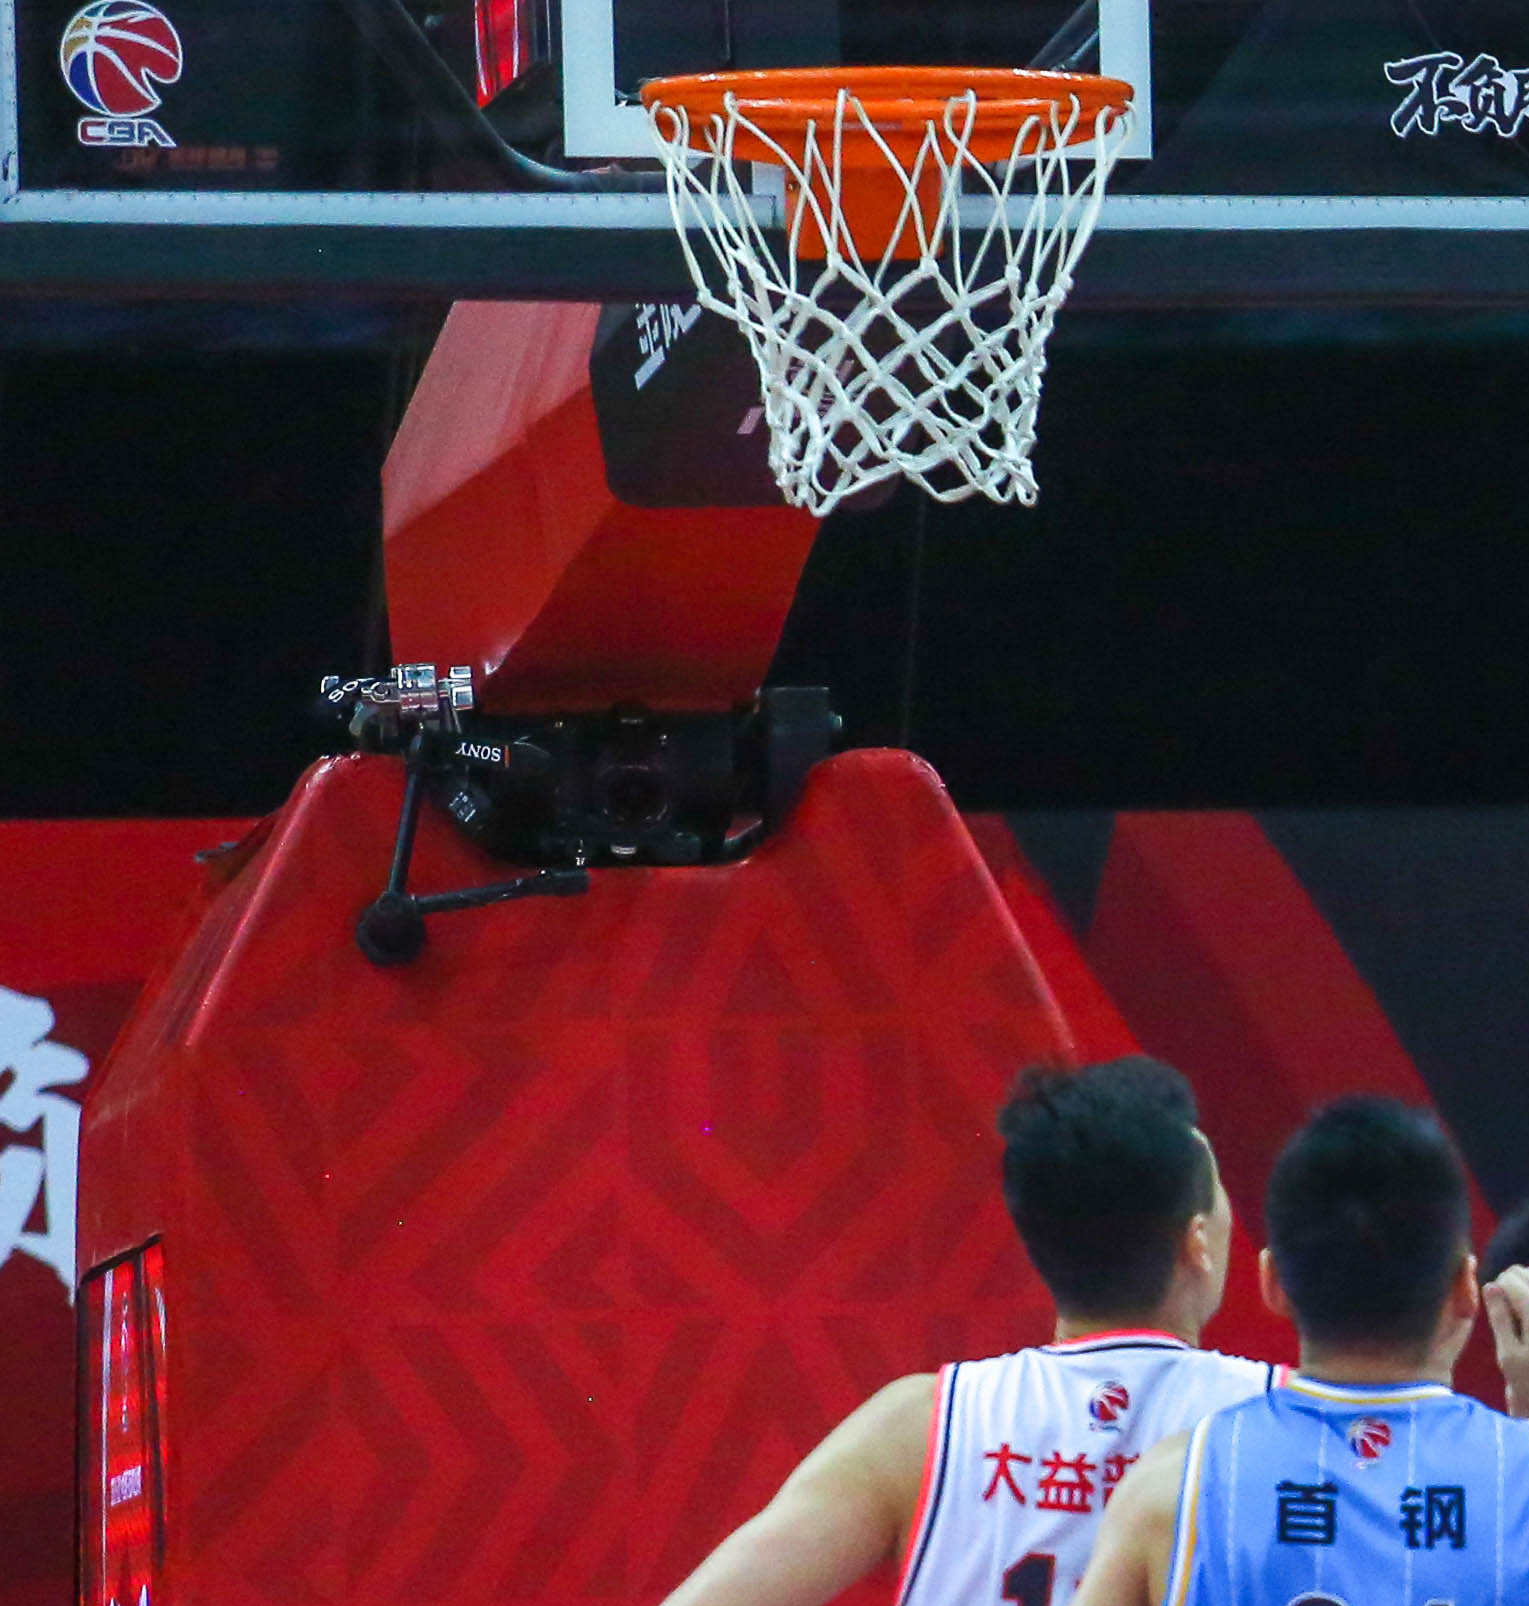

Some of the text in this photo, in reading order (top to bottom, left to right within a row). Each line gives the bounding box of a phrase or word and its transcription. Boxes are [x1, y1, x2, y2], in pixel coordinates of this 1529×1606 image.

[78, 117, 177, 148] CBA
[455, 742, 501, 762] SONY
[1275, 1480, 1468, 1552] 首钢
